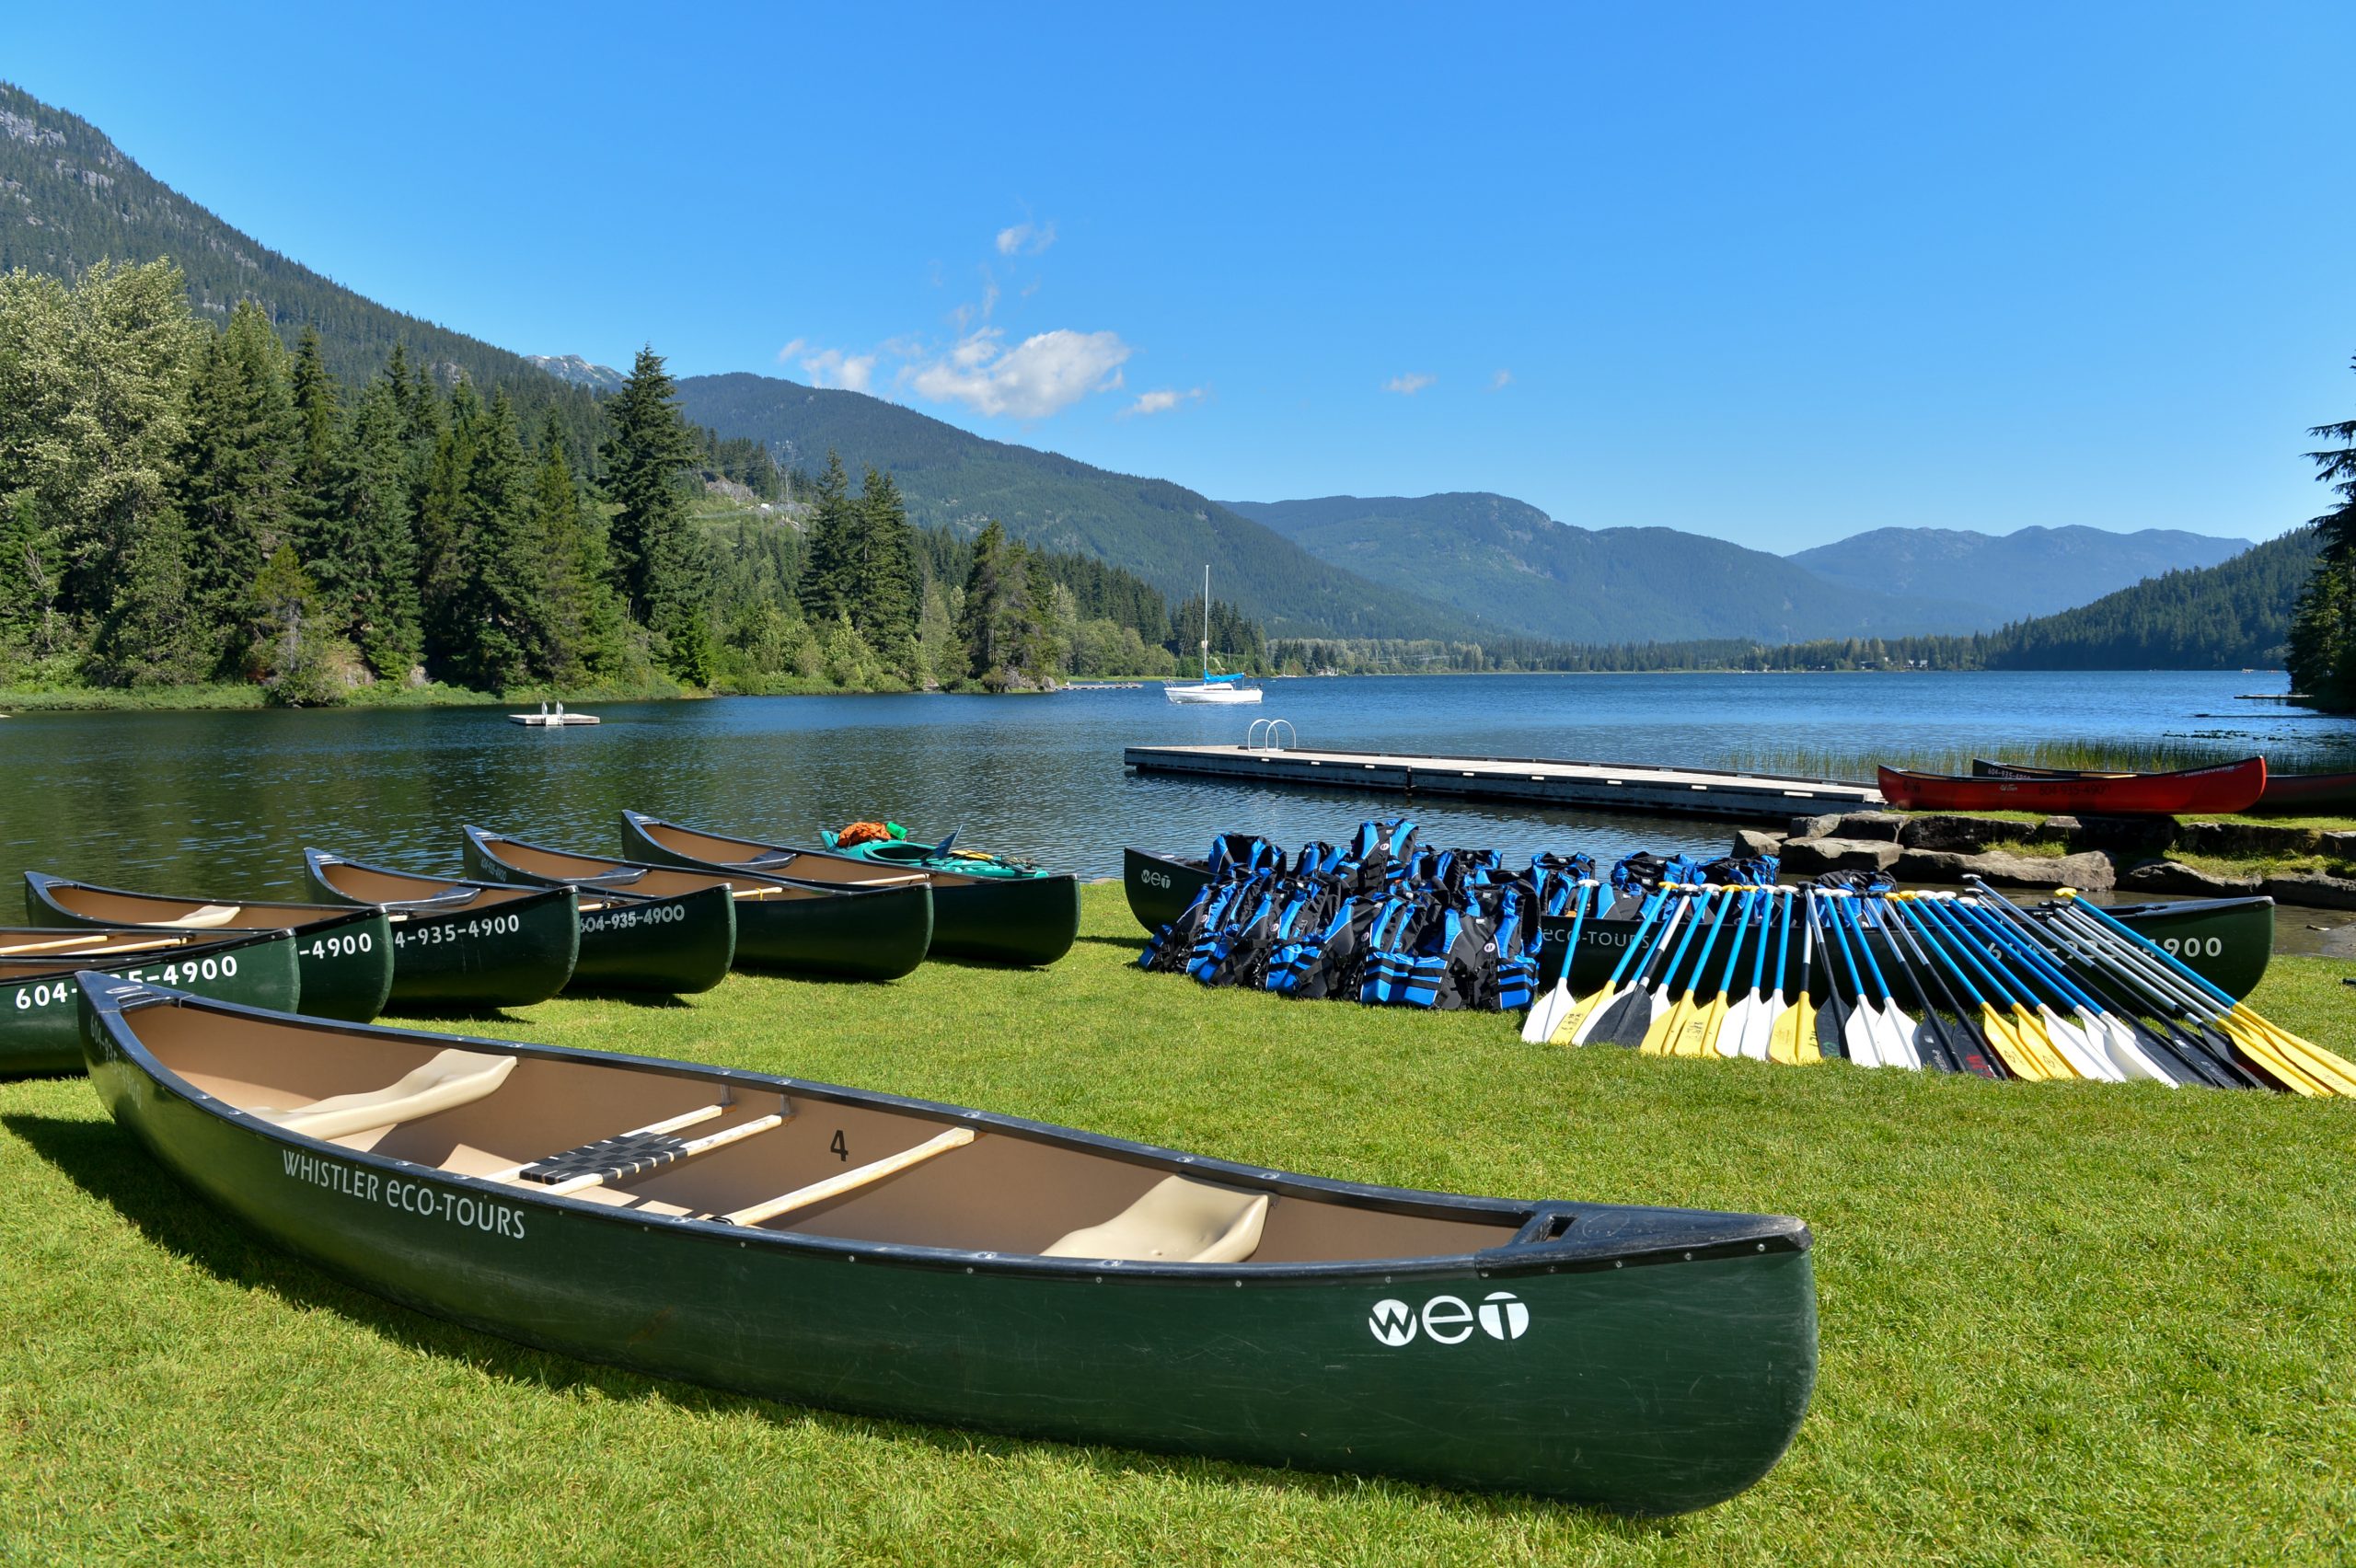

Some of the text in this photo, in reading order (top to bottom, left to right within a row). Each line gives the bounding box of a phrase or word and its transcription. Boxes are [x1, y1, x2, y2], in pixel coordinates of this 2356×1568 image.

[16, 955, 237, 1009] 604-5-4900
[830, 1129, 849, 1162] 4
[283, 1149, 379, 1202] WHISTLER
